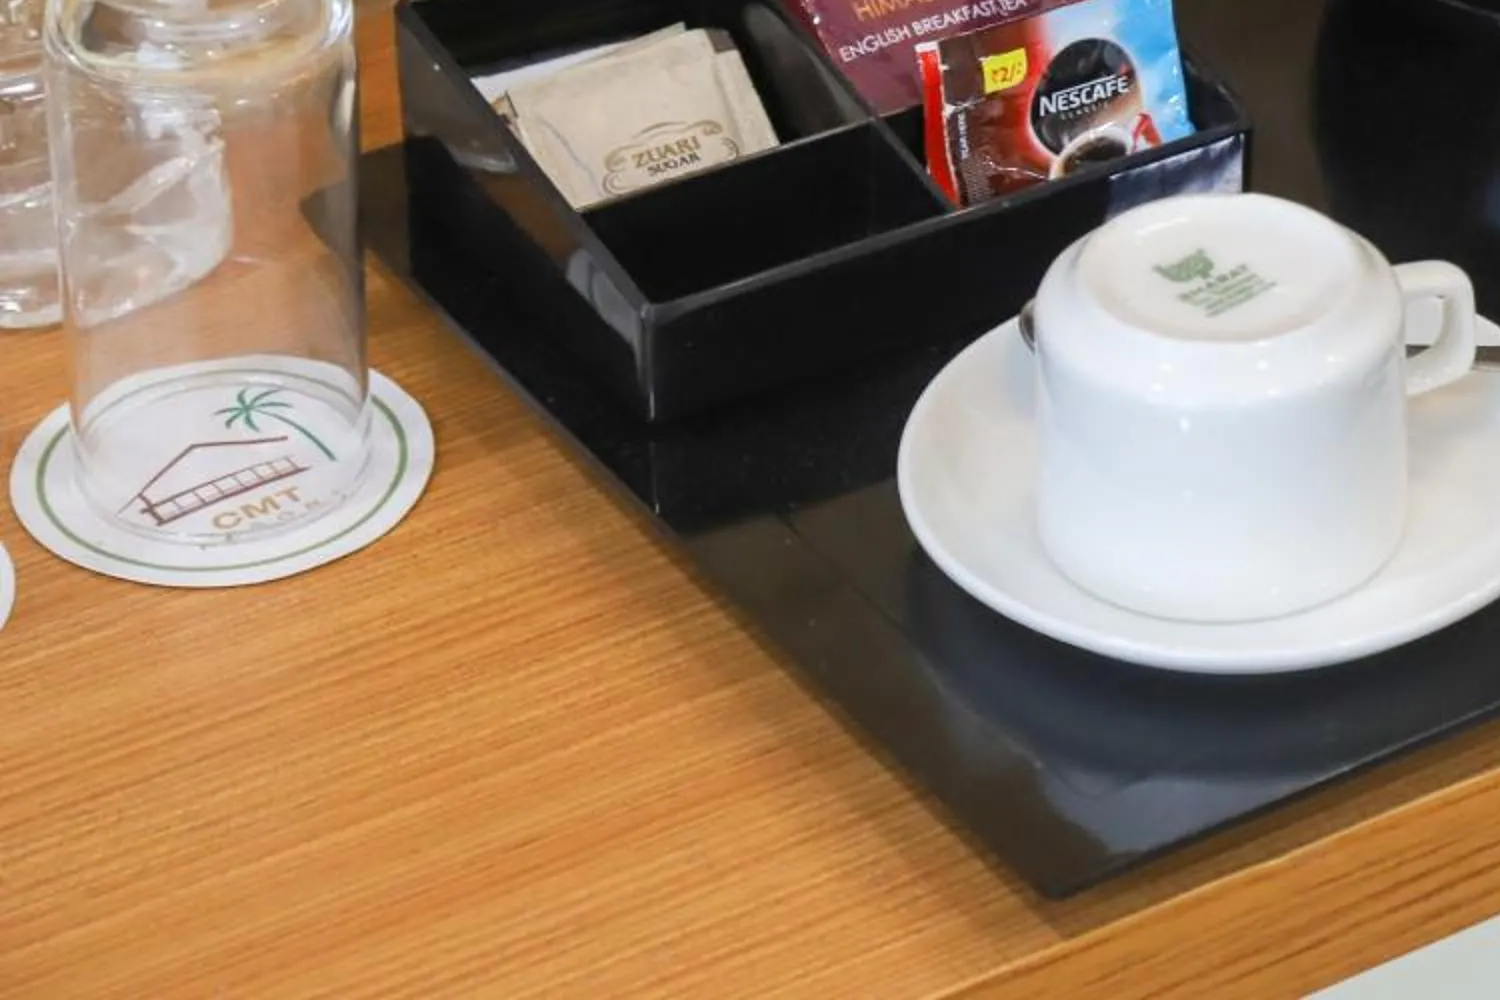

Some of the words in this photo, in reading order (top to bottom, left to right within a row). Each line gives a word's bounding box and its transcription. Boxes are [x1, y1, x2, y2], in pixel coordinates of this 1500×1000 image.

[839, 26, 911, 63] ENGLISH
[912, 1, 998, 36] BREAKFAST
[631, 135, 702, 168] ZUARI
[648, 152, 702, 177] SUGAR
[212, 485, 301, 530] CMT
